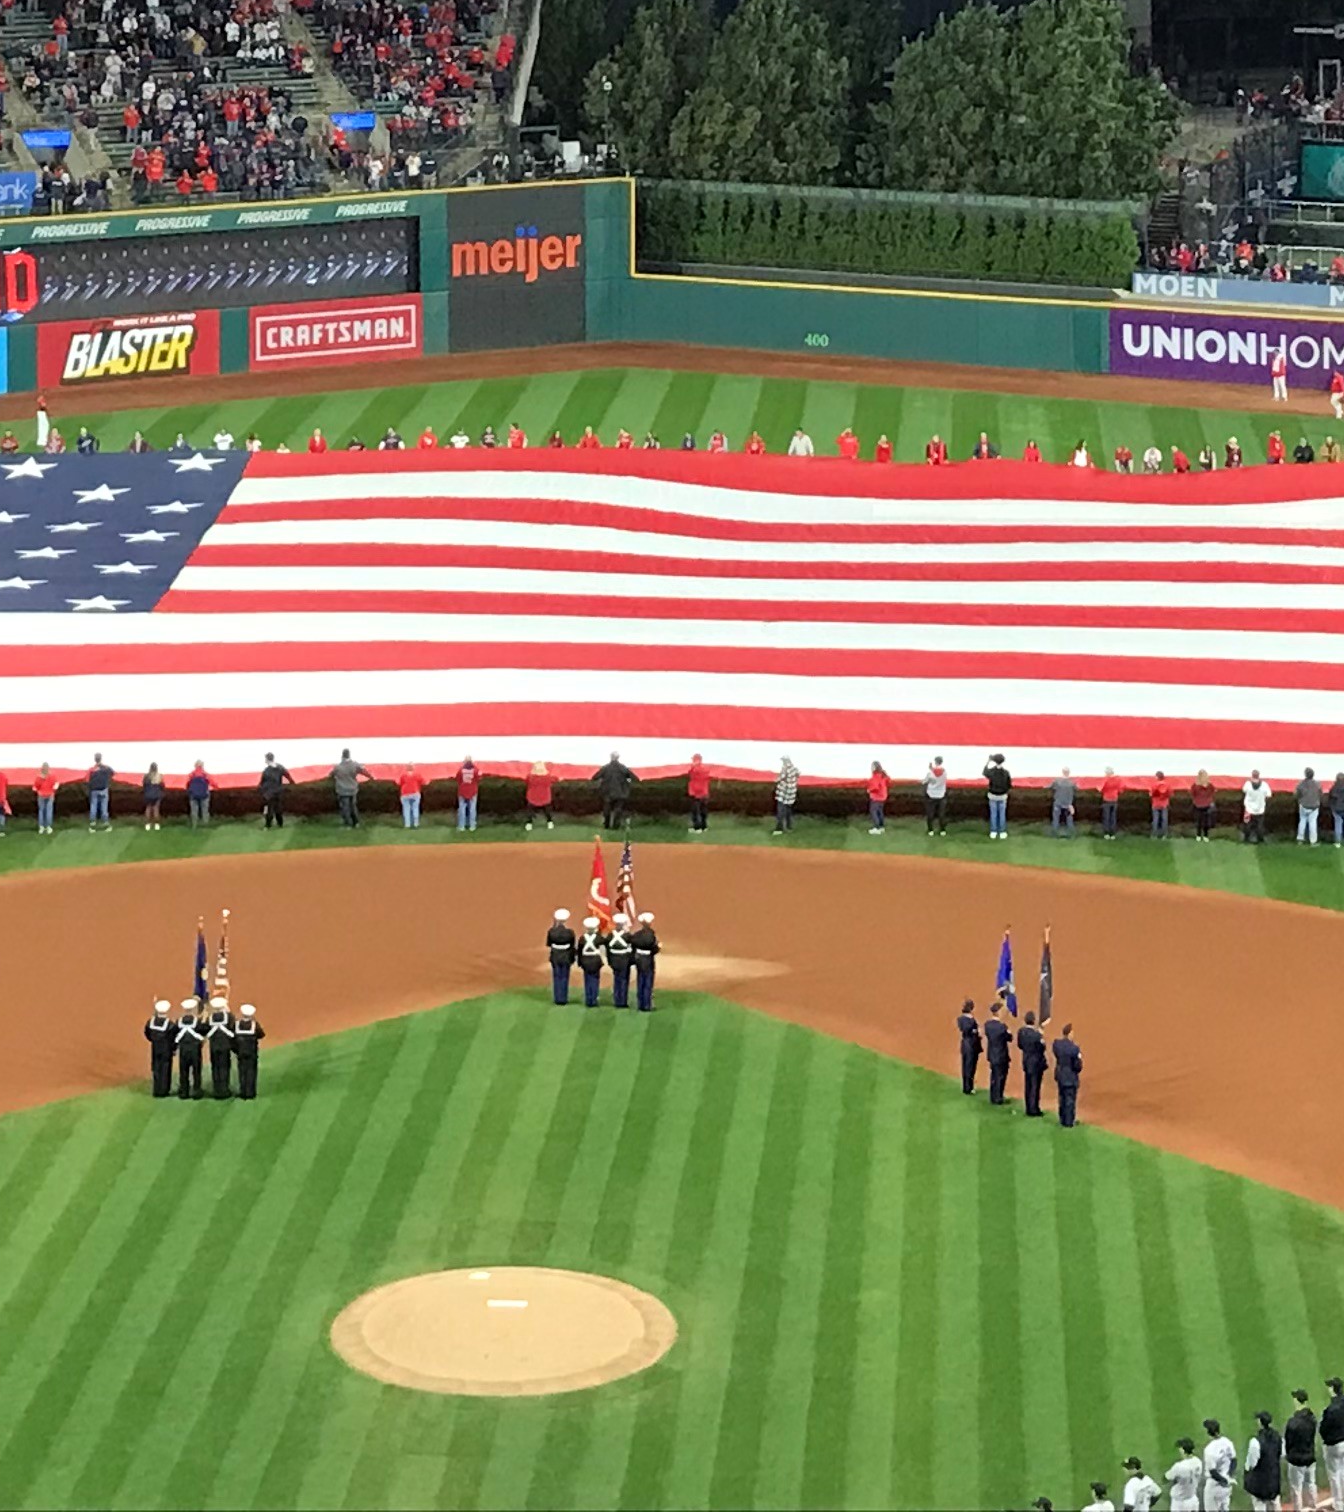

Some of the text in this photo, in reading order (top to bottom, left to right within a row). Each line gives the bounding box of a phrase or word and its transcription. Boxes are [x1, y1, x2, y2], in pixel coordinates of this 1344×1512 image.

[31, 221, 110, 239] PROGRESSIVE
[135, 214, 212, 231] PROGRESSIVE
[236, 207, 312, 224] PROGRESSIVE
[335, 200, 408, 217] PROGRESSIVE
[452, 226, 582, 283] meijer
[1135, 273, 1218, 299] MOEN
[266, 316, 405, 349] CRAFTSMAN
[805, 333, 829, 347] 400
[63, 325, 194, 379] BLASTER
